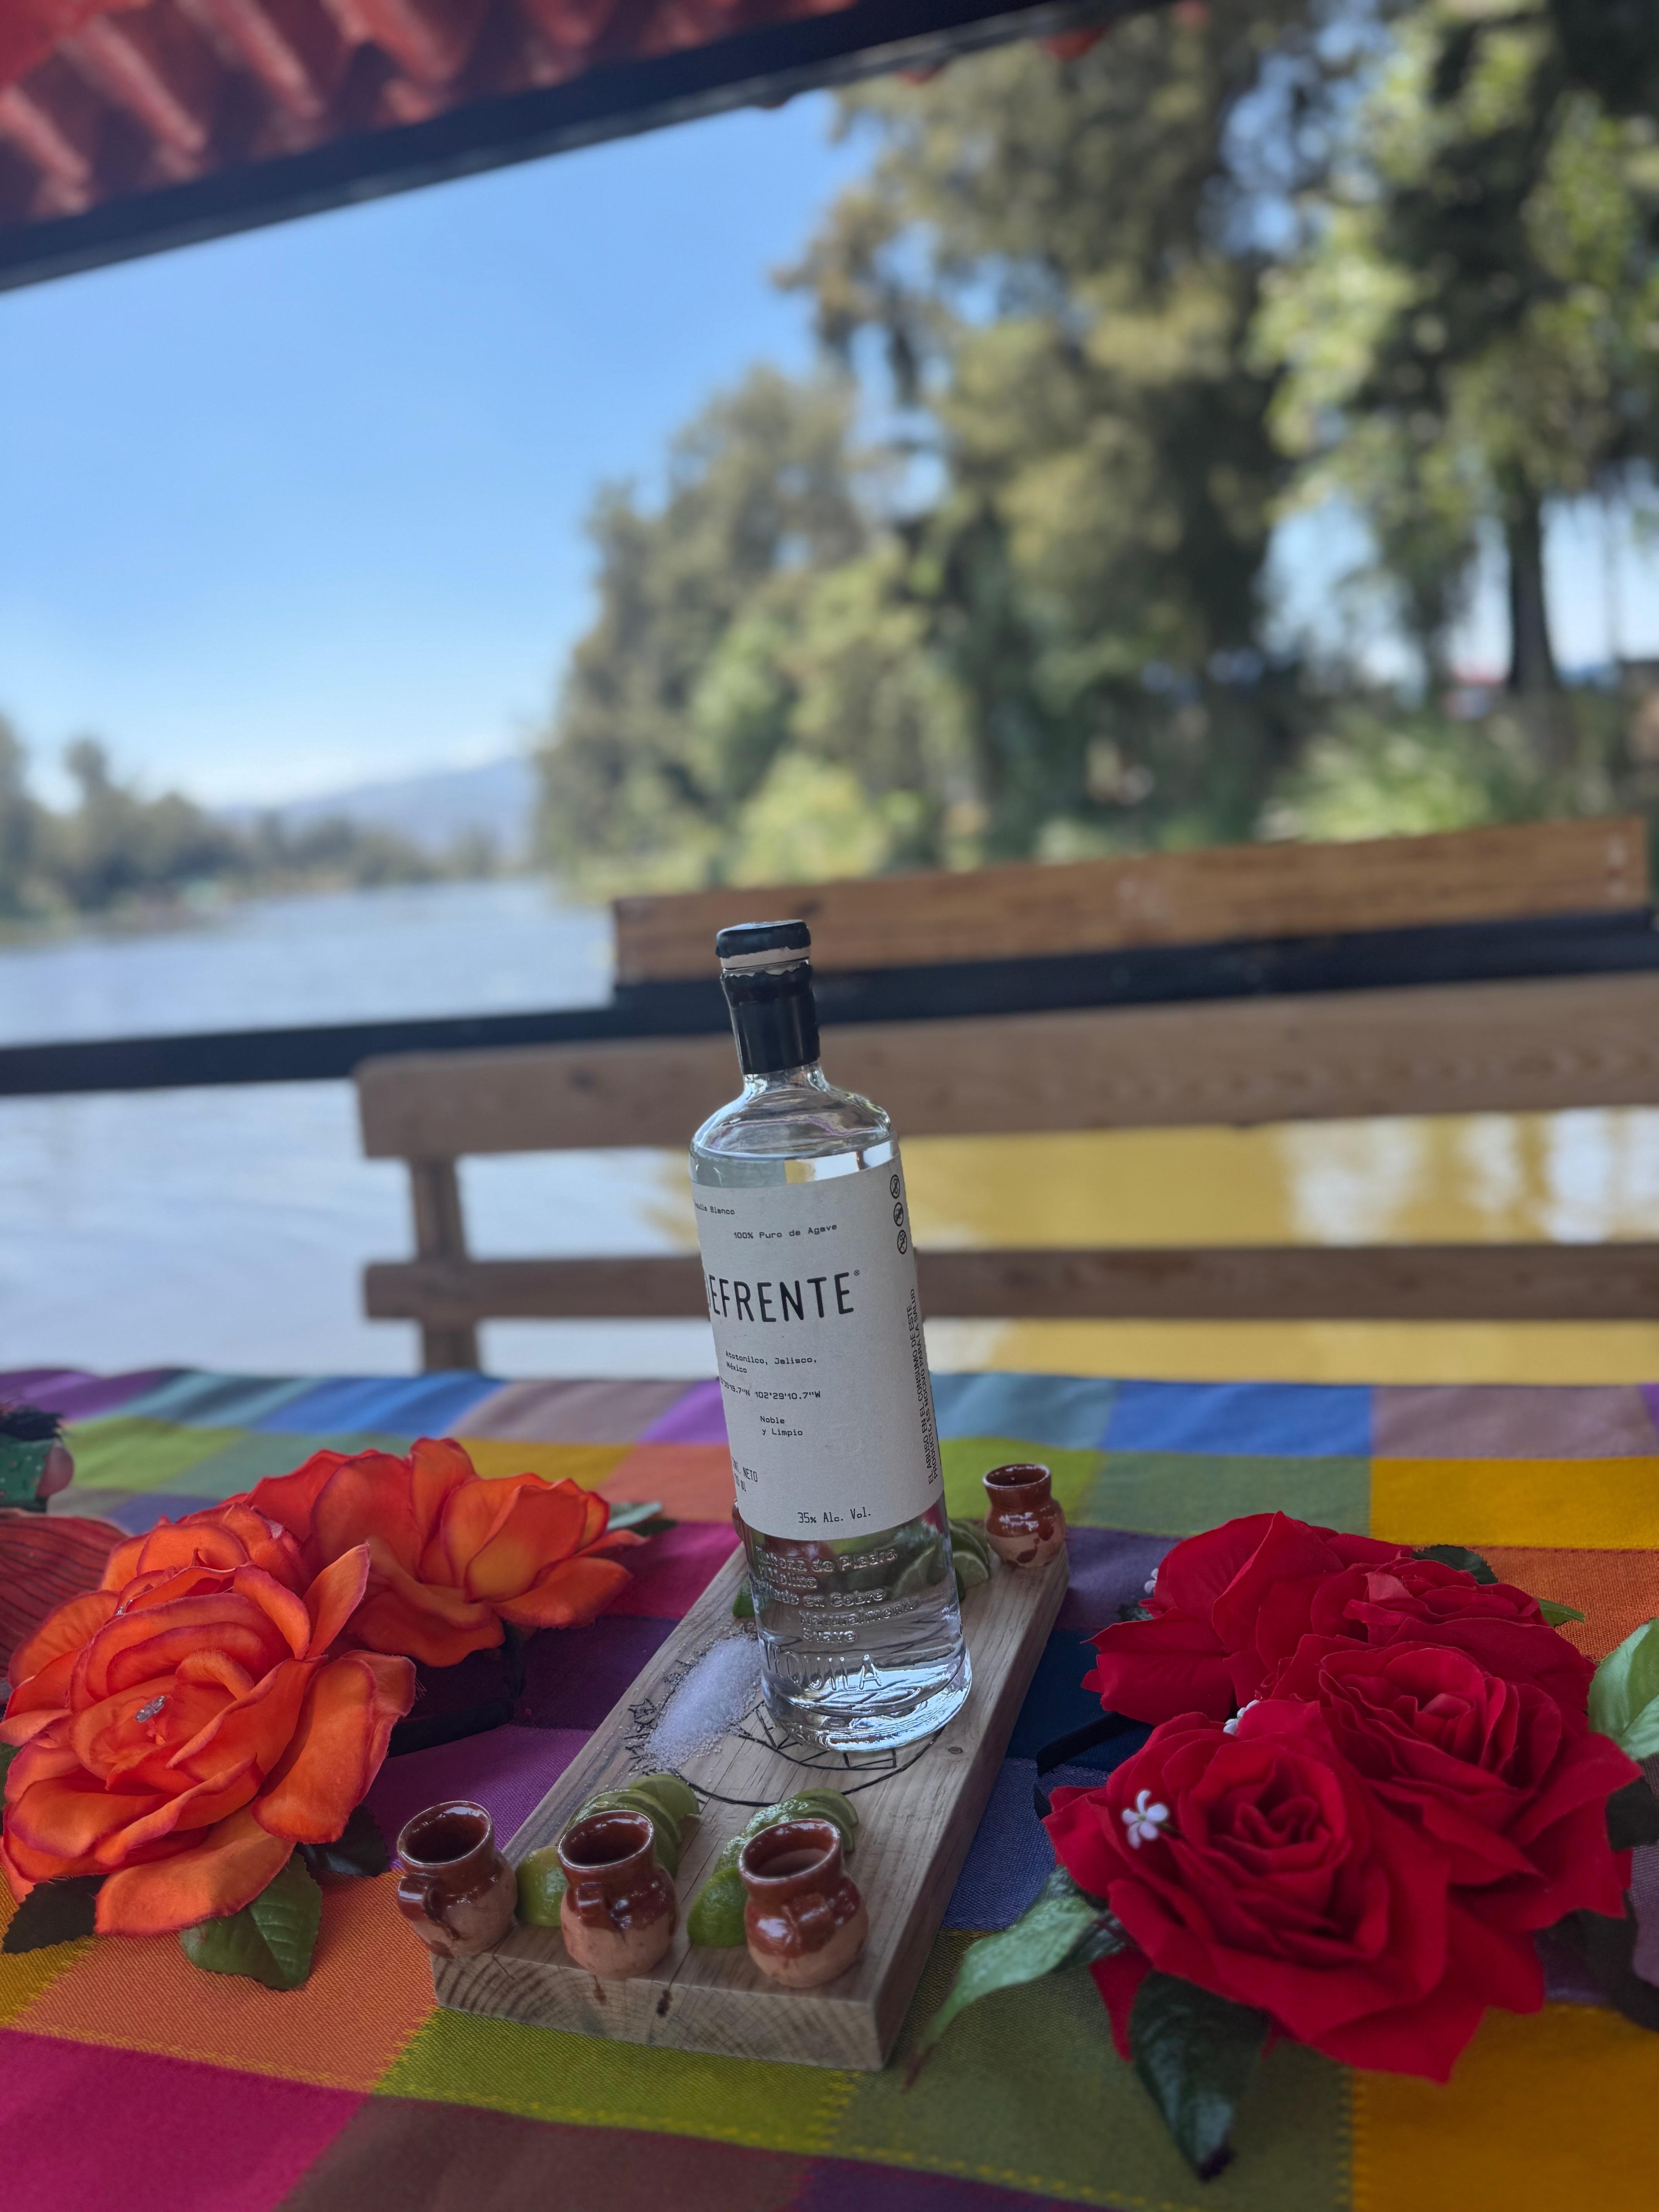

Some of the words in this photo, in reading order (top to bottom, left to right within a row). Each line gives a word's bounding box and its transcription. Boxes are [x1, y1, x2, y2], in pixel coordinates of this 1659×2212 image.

[710, 1206, 735, 1215] Blanco
[808, 1224, 837, 1235] Agave
[705, 1272, 854, 1322] EFRENTE
[915, 1323, 920, 1338] LA
[910, 1332, 917, 1348] DE
[726, 1351, 768, 1365] Atotonilco,
[726, 1362, 747, 1373] México
[912, 1350, 923, 1401] CONSUMO
[921, 1369, 929, 1407] NOCIVO
[920, 1402, 925, 1417] EL
[926, 1408, 931, 1422] ES
[760, 1415, 785, 1424] Noble
[921, 1419, 927, 1433] EN
[772, 1428, 803, 1437] Limpio
[924, 1435, 932, 1468] ABUSO
[743, 1467, 758, 1482] NETO
[928, 1470, 934, 1484] EL
[797, 1512, 817, 1523] 35%
[850, 1507, 871, 1519] Vol.
[811, 1558, 836, 1573] de
[830, 1588, 886, 1607] Cobre
